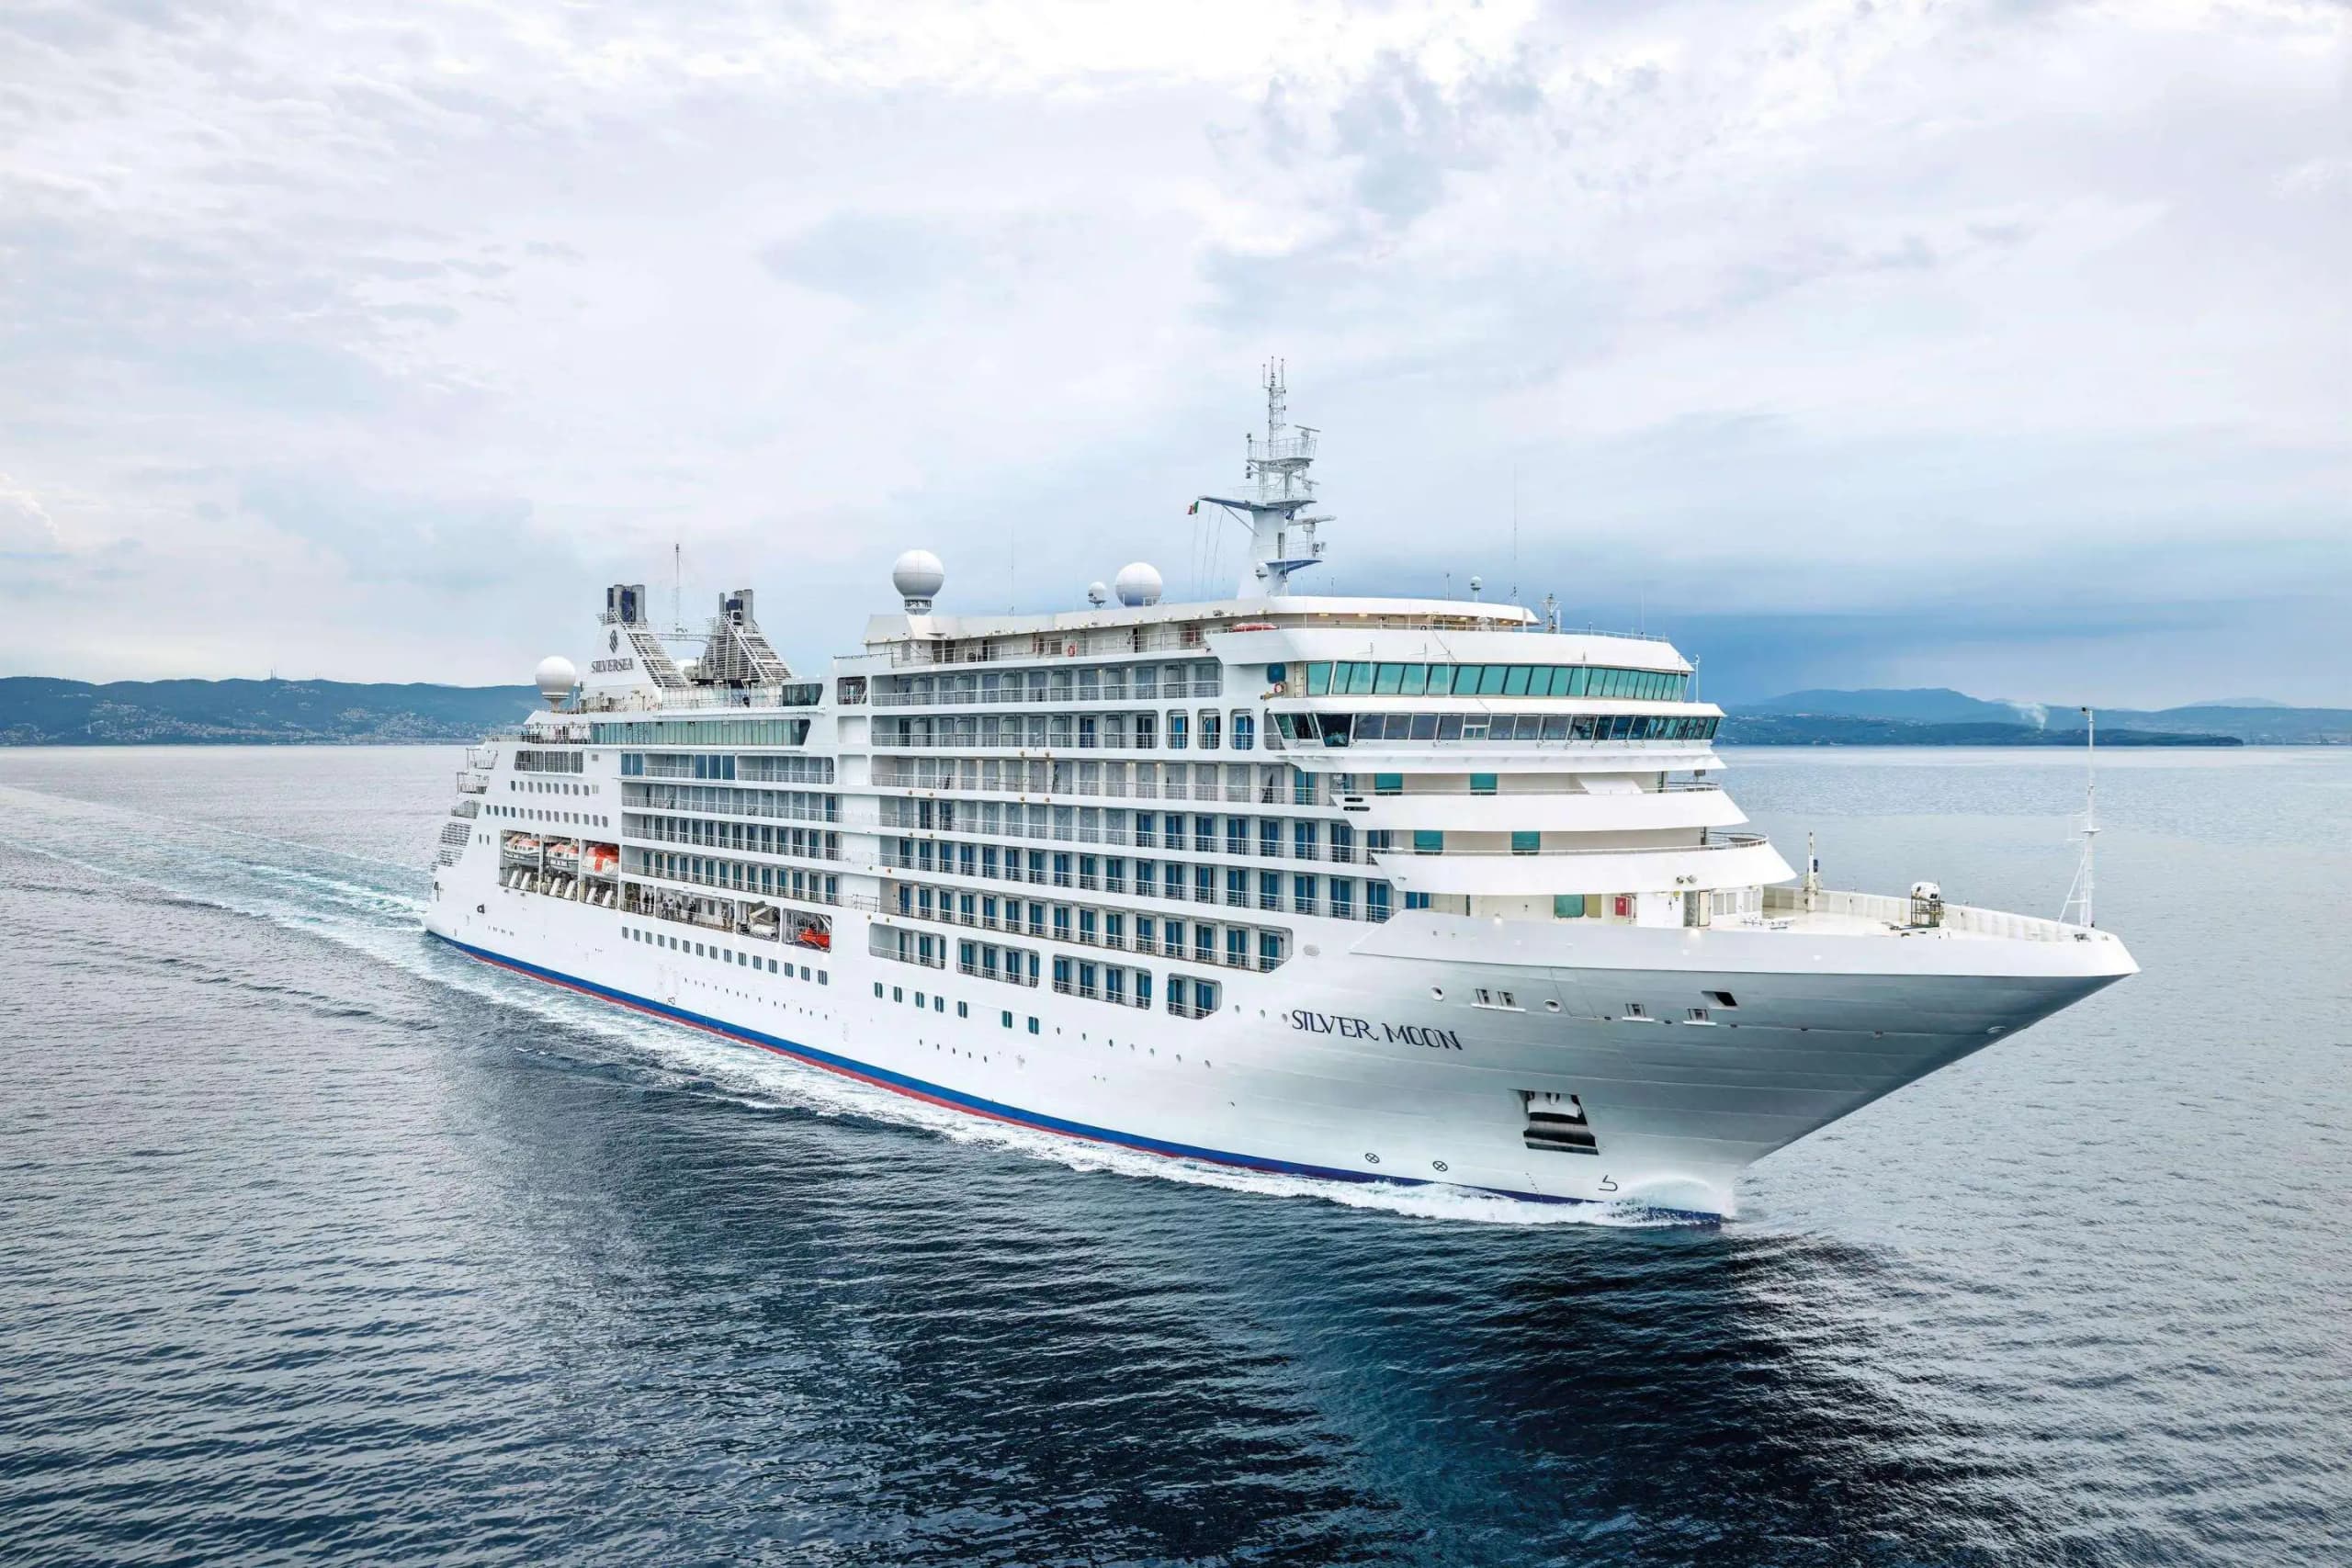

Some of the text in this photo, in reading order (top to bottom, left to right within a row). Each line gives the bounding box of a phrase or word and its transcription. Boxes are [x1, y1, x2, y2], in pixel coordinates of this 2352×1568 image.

[591, 658, 634, 673] SILVERSEA
[1292, 1010, 1463, 1050] SILVER MOON
